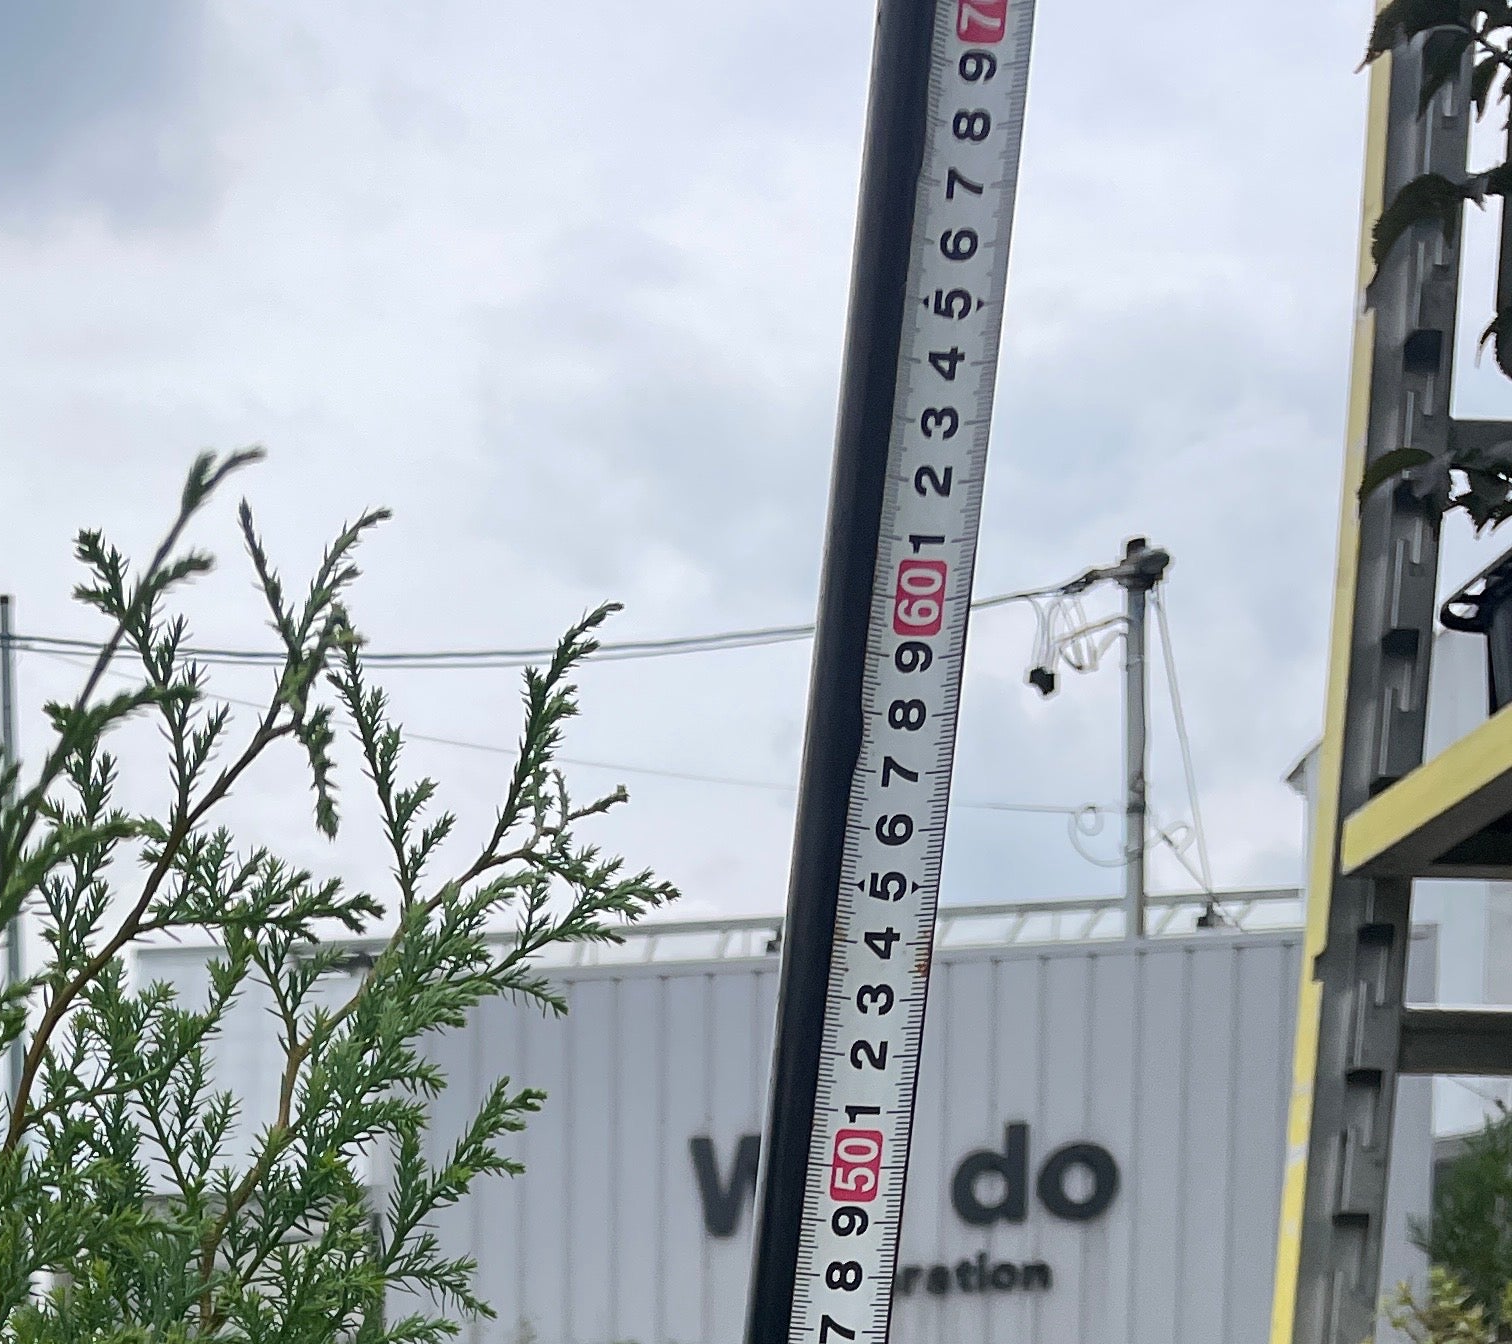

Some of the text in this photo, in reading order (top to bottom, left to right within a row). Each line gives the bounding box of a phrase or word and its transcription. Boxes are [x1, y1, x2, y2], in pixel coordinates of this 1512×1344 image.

[960, 0, 1002, 33] 7
[959, 49, 996, 82] 9
[953, 110, 991, 142] 8
[946, 168, 983, 201] 7
[940, 229, 978, 261] 6
[934, 288, 972, 320] 5
[928, 346, 965, 380] 4
[921, 407, 959, 440] 3
[915, 465, 952, 498] 2
[908, 533, 946, 554] 1
[898, 564, 943, 627] 60
[895, 641, 932, 673] 9
[888, 699, 926, 731] 8
[882, 756, 919, 788] 7
[876, 814, 913, 845] 6
[869, 872, 906, 902] 5
[864, 927, 901, 959] 4
[857, 984, 894, 1015] 3
[850, 1040, 888, 1070] 2
[845, 1105, 881, 1123] 1
[837, 1138, 879, 1192] 50
[950, 1121, 1120, 1226] do
[832, 1206, 868, 1236] 9
[826, 1261, 862, 1291] 8
[893, 1253, 1053, 1298] ration
[819, 1315, 855, 1344] 7
